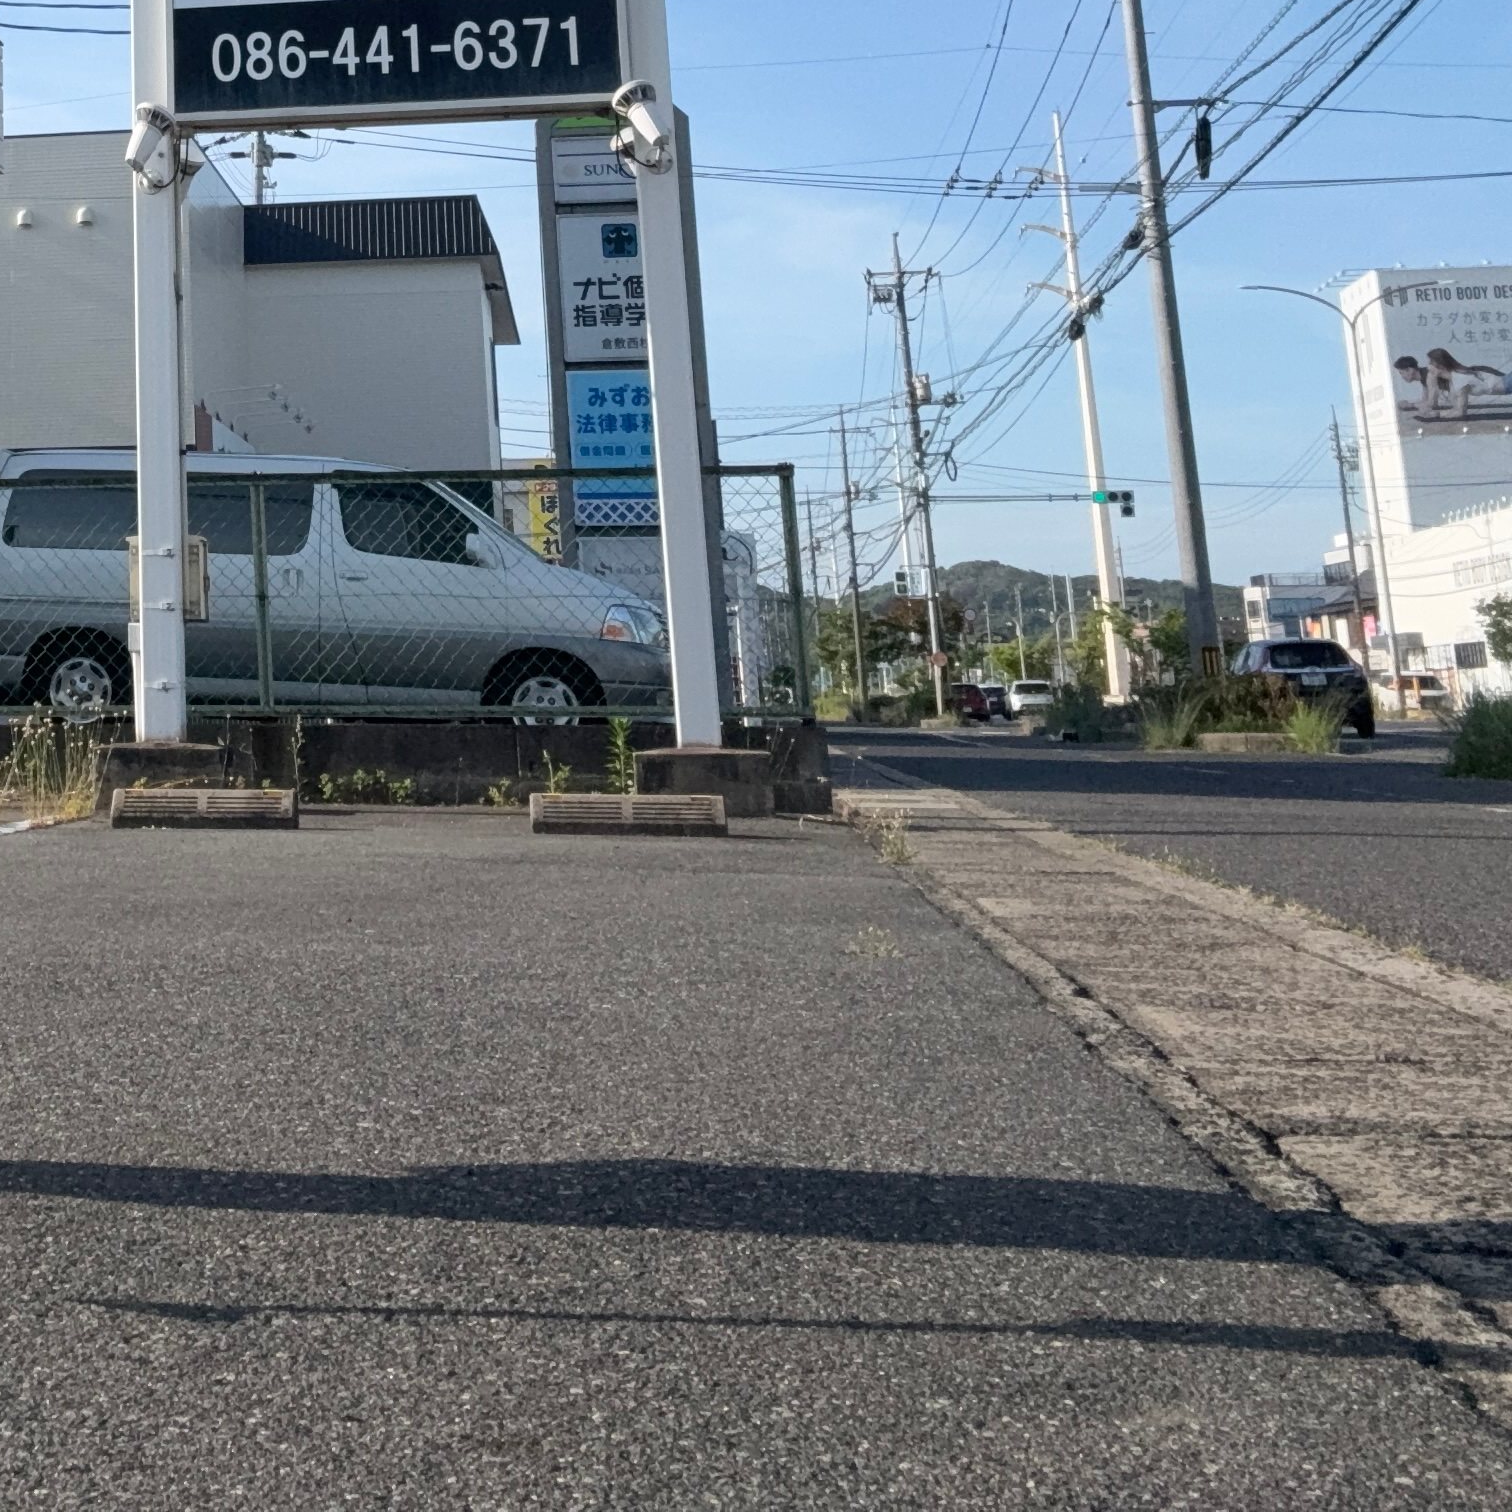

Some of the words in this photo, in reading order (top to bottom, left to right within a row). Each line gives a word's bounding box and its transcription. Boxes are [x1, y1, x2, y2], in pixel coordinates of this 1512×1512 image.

[212, 16, 581, 82] 086-441-6371
[1416, 286, 1452, 302] RETIO
[1456, 285, 1488, 300] BODY
